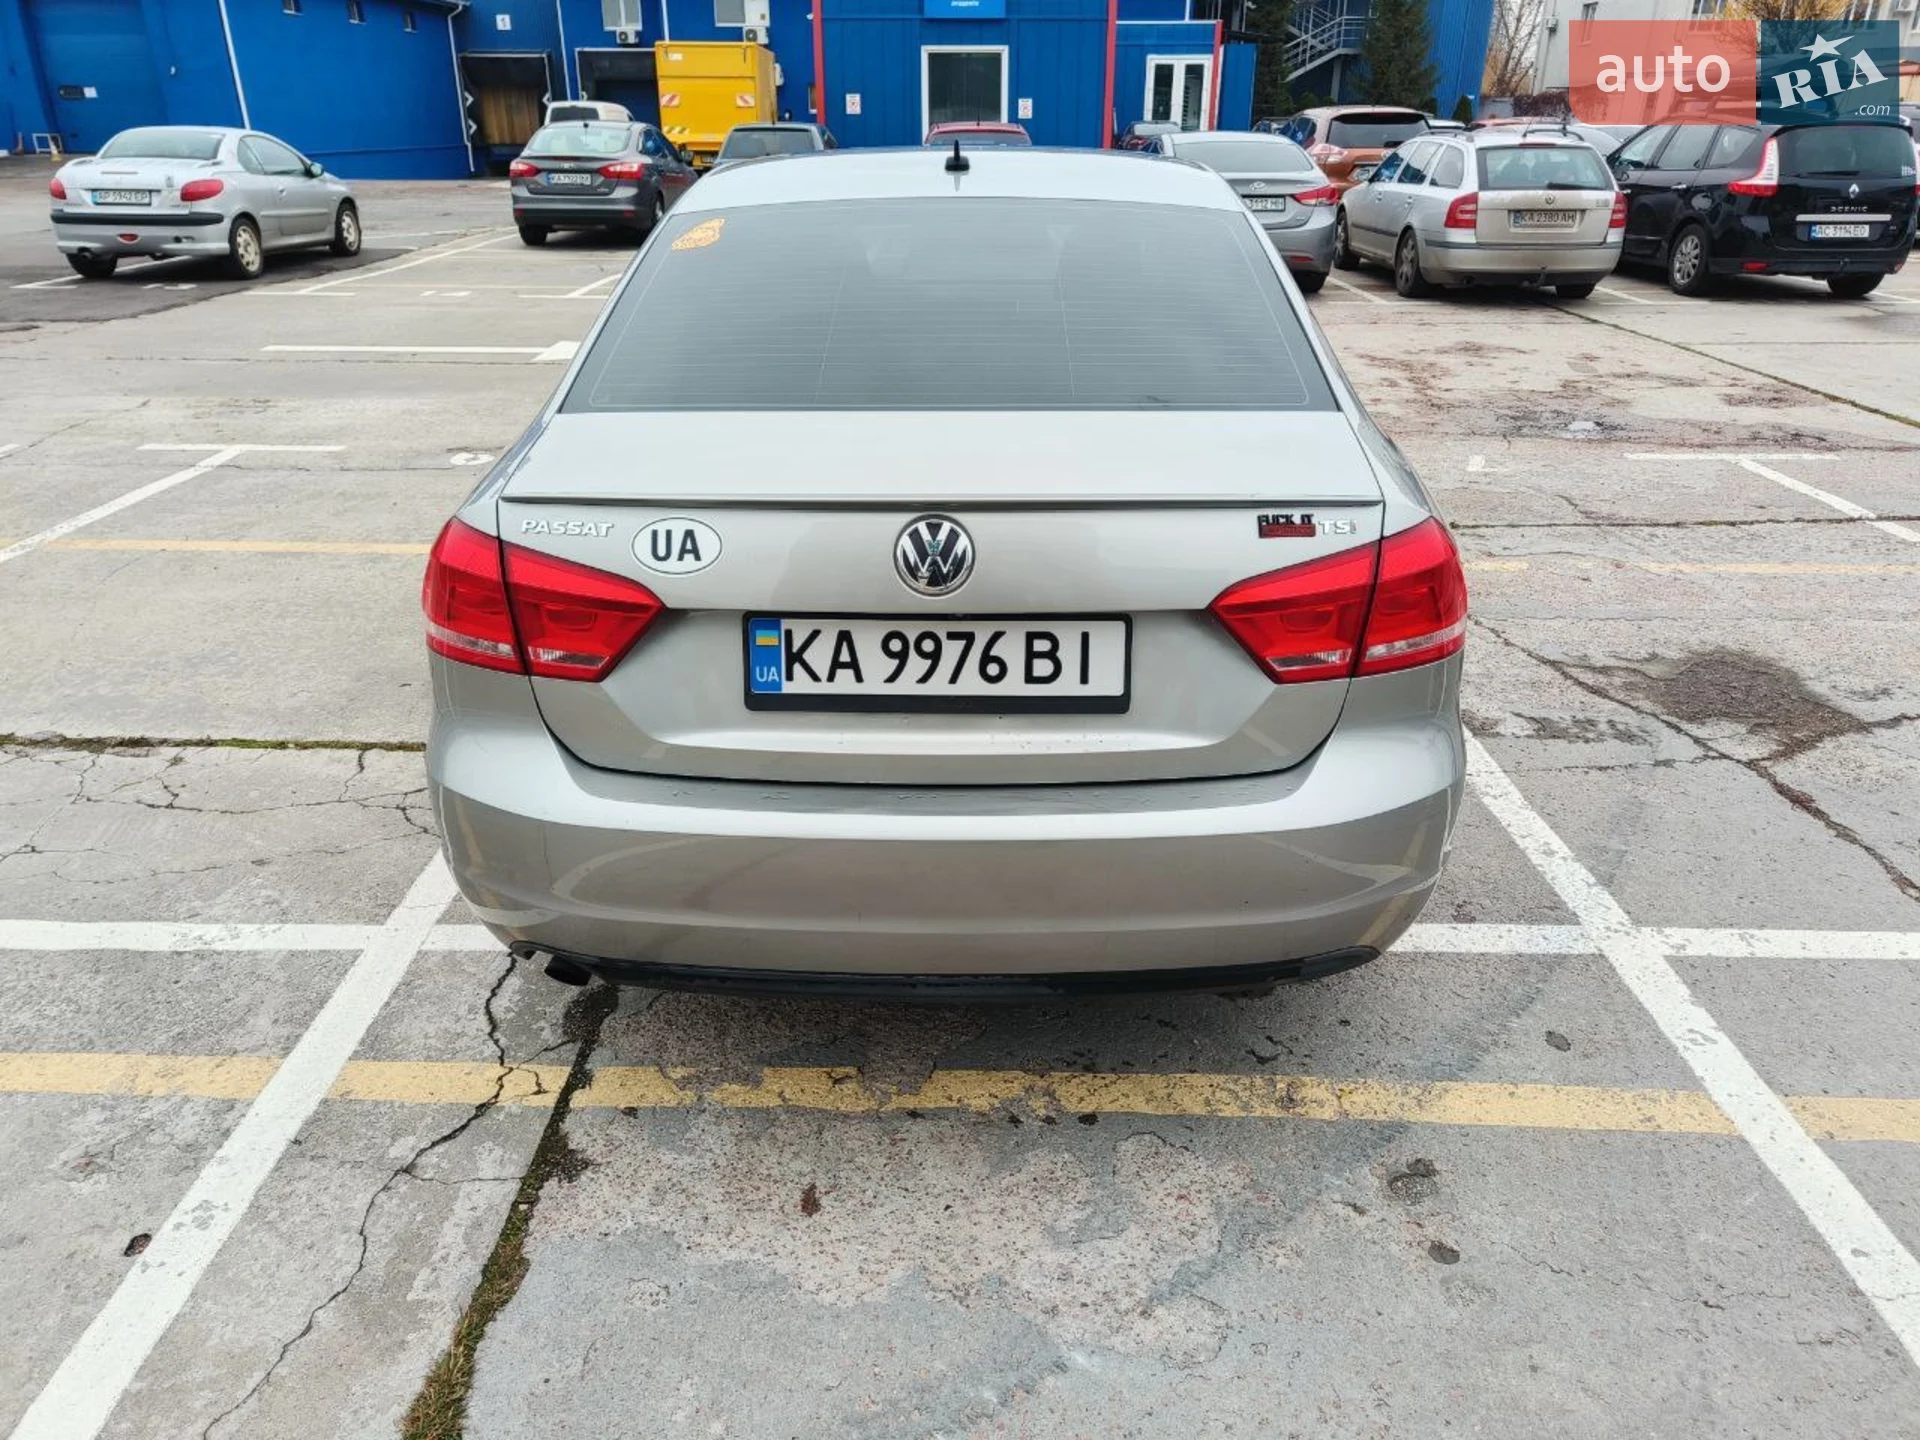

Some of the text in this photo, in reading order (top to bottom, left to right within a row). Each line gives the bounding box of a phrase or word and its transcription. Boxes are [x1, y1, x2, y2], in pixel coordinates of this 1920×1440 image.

[1520, 212, 1576, 222] KA 2380 AH
[521, 518, 614, 538] PASSAT
[1257, 513, 1315, 526] FUCK IT
[650, 528, 702, 562] UA
[783, 628, 1091, 686] KA 9976 BI
[756, 664, 780, 683] UA
